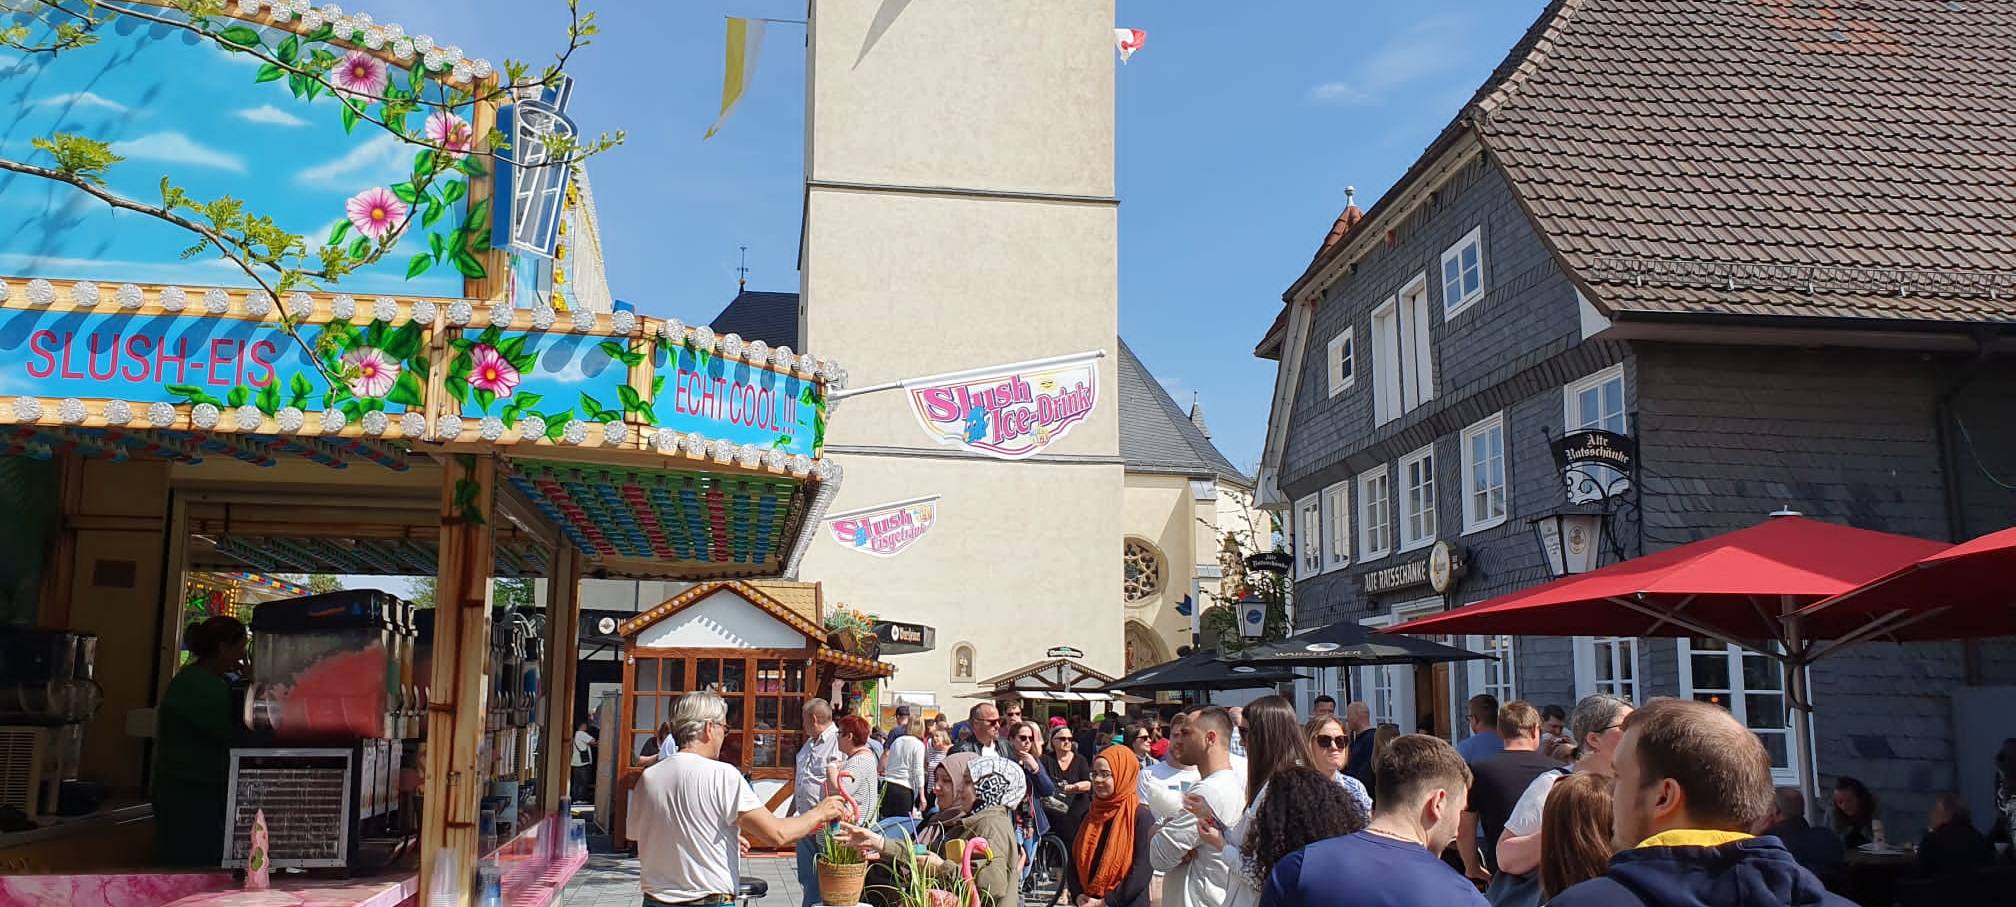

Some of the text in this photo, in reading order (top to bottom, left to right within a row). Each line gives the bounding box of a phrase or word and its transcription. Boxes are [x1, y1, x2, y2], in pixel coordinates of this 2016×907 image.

[26, 329, 278, 388] SLUSH-EIS
[675, 368, 727, 420] ECHT
[729, 380, 780, 432] COOL
[922, 373, 1033, 423] Slush
[991, 380, 1092, 445] Ice-Drink
[1586, 433, 1609, 448] Alte
[831, 507, 914, 543] Slush
[1364, 571, 1378, 593] ALTE
[1378, 559, 1426, 589] RATSSCHÄNKE
